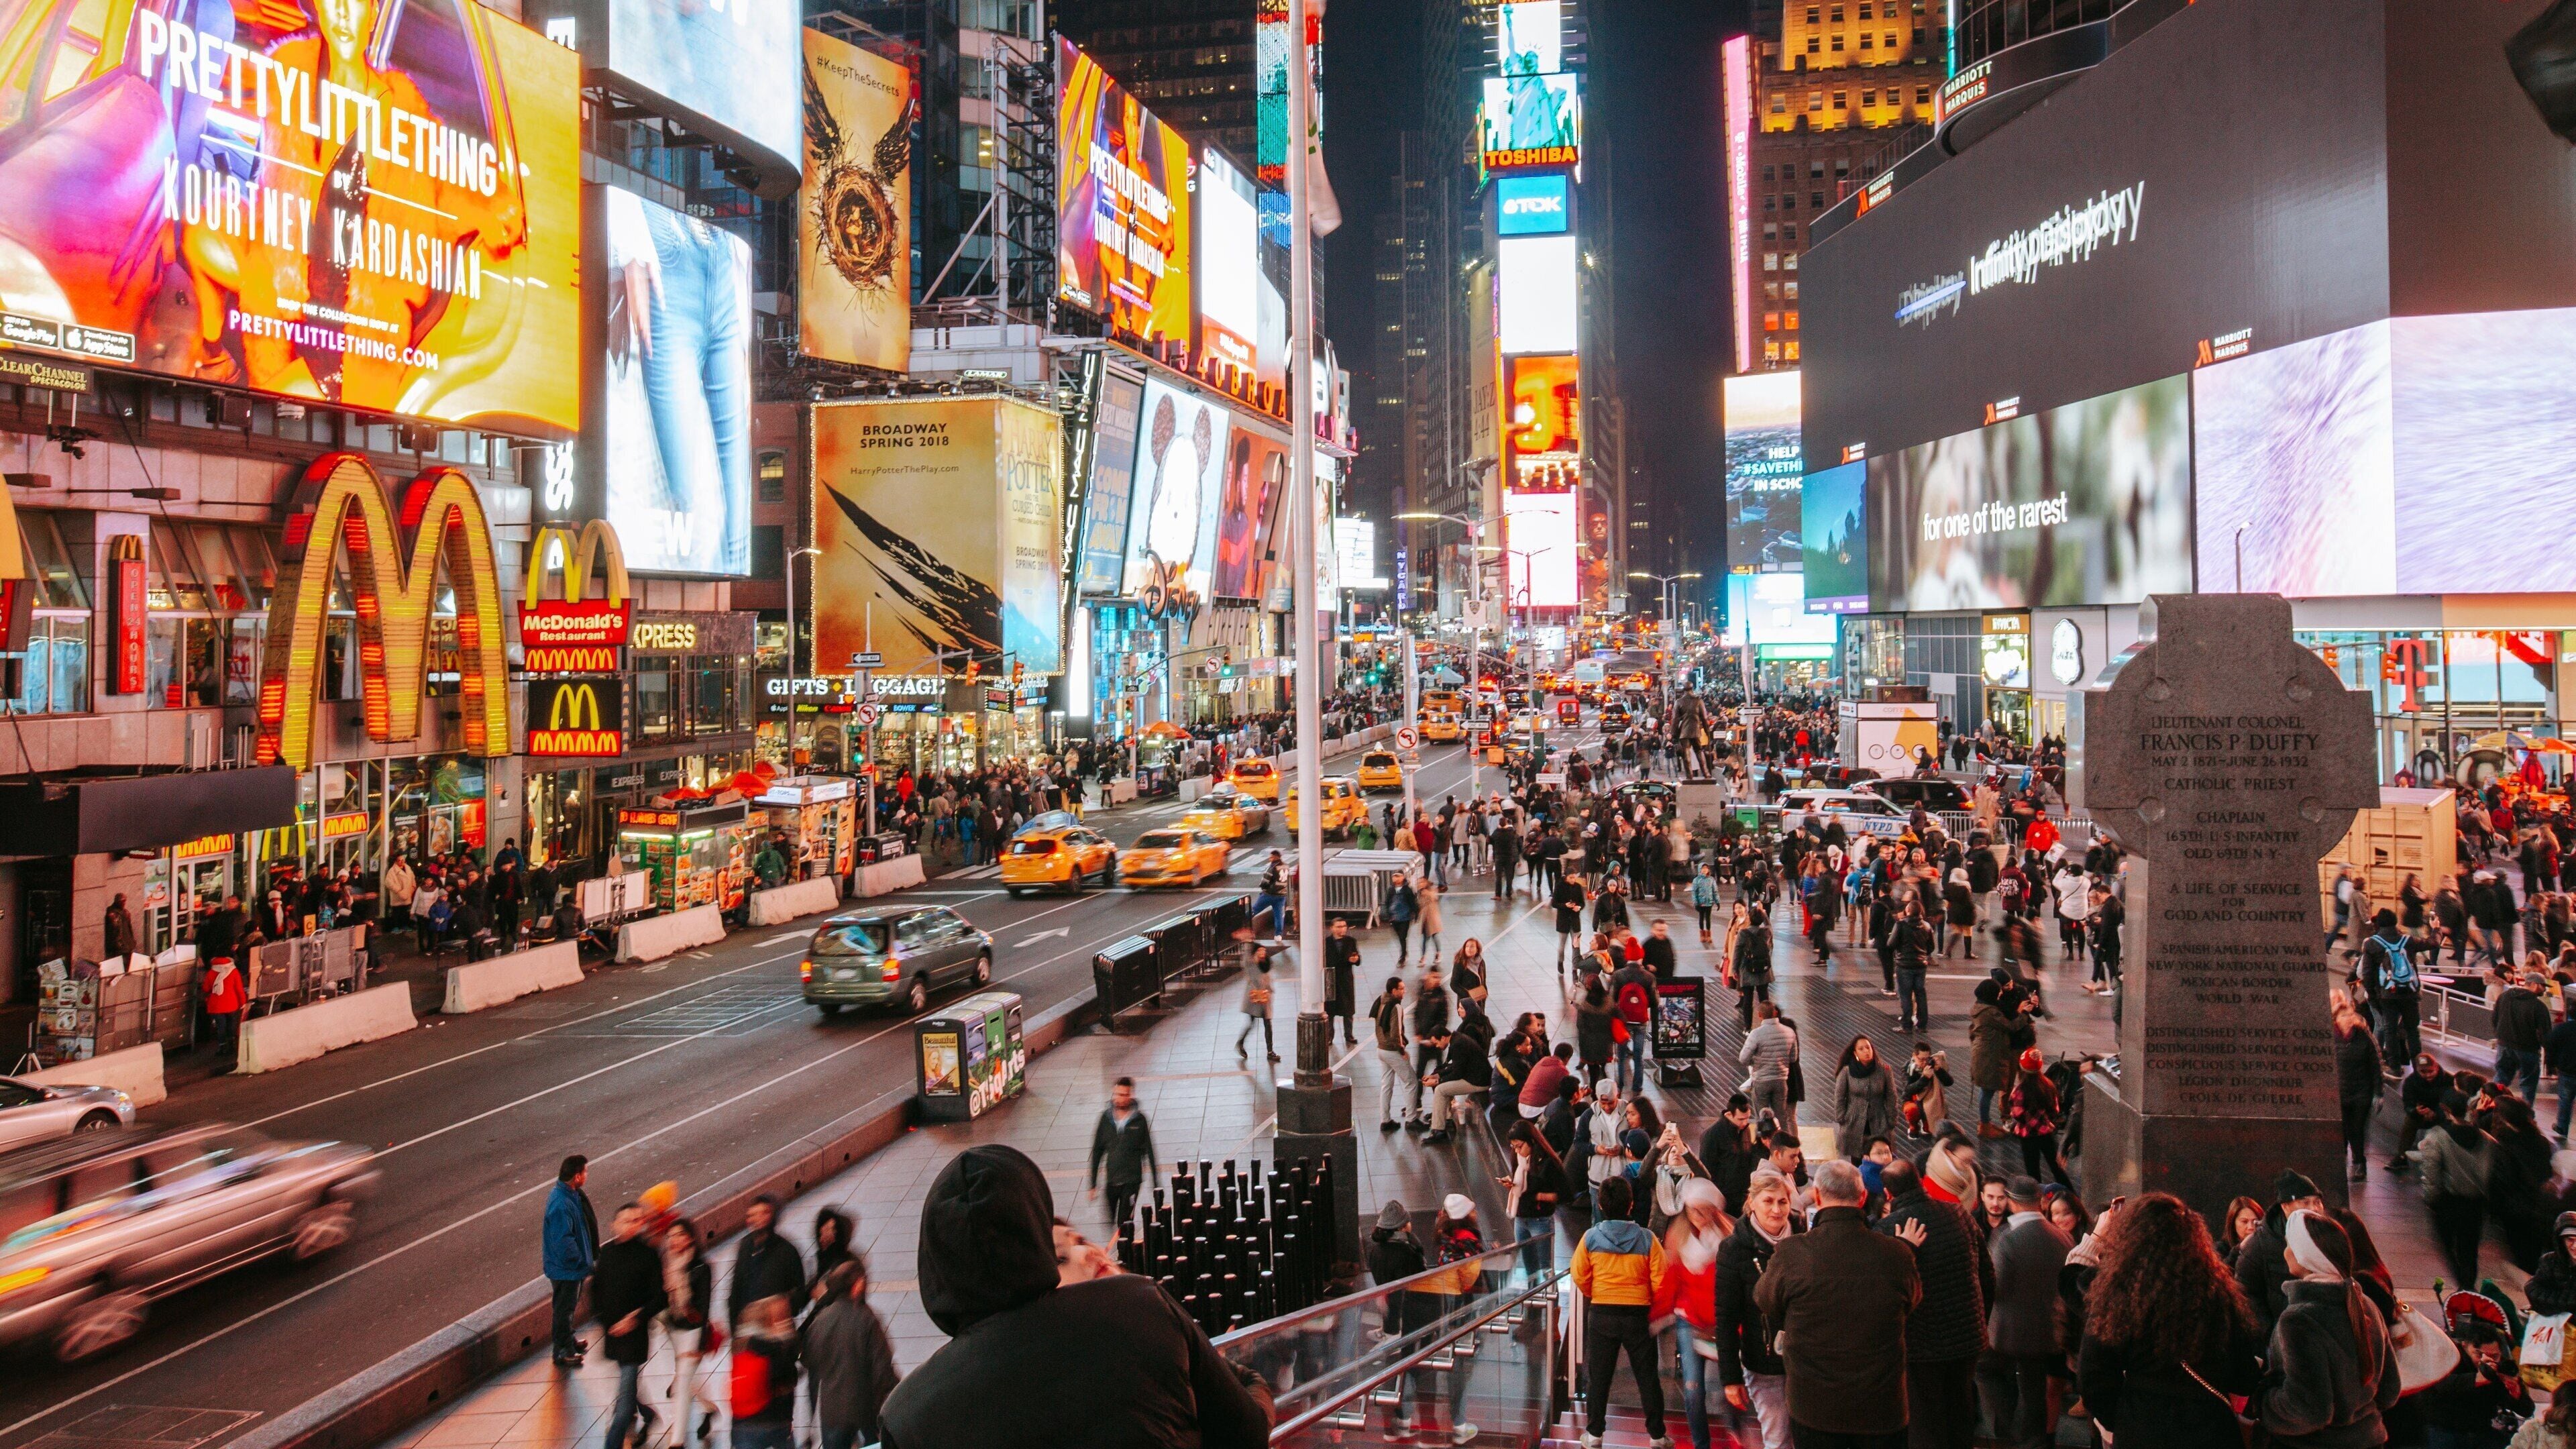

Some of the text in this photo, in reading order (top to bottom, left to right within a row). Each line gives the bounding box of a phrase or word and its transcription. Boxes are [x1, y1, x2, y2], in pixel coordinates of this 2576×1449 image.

[816, 55, 900, 98] #KeepTheSecrets
[1945, 61, 1992, 97] MARRIOTT
[1945, 81, 1985, 115] MARQUIS
[140, 13, 497, 197] PRETTYLITTLETHING
[1486, 146, 1576, 166] TOSHIBA
[333, 170, 352, 191] BY
[1089, 141, 1169, 225] PRETTYLITTLETHING
[1869, 171, 1894, 195] MARRIOTT
[1869, 185, 1891, 207] MARQUIS
[164, 157, 480, 301] KOURTNEY KARDASHIAN
[303, 303, 318, 316] THE
[3, 323, 56, 345] Google Play
[229, 309, 439, 370] PRETTYLITTLETHING.COM
[2214, 328, 2252, 347] MARRIOTT
[83, 338, 129, 357] App Store
[2215, 341, 2248, 360] MARQUIS
[30, 375, 87, 390] SPECTACOLOR
[1155, 331, 1224, 388] 1540
[1226, 365, 1336, 441] BROAAY
[1996, 396, 2020, 411] MARRIOTT
[863, 423, 947, 435] BROADWAY
[860, 436, 950, 448] SPRING 2018
[1010, 419, 1053, 463] HARRY
[1769, 446, 1799, 459] HELP
[850, 464, 959, 476] HarryPotterThePlay.com
[1006, 452, 1056, 496] POTTER
[1754, 480, 1768, 491] IN
[1923, 491, 2068, 541] for one of the rarest
[1016, 546, 1049, 559] BROADWAY
[1016, 559, 1036, 570] SPRING
[127, 568, 141, 687] OPEN 24 HOURS
[524, 614, 623, 631] McDonald's
[539, 631, 606, 641] Restaurant
[633, 623, 696, 649] XPRESS
[767, 678, 946, 696] GIFTS LGGAGE
[796, 704, 819, 712] Nikon
[2151, 716, 2305, 729] LIEUTENANT COLONEL
[2140, 734, 2222, 751] FRANCIS
[2249, 734, 2319, 751] DUFFY
[2151, 756, 2178, 767] MAY
[2180, 756, 2188, 767] 2
[2262, 756, 2276, 767] 26
[2281, 756, 2308, 767] 1932
[611, 774, 645, 788] EXPRESS
[660, 769, 689, 782] EXPRESS
[2164, 778, 2296, 790] CATHOLIC PRIEST
[2196, 812, 2265, 823] CHAPLAIN
[1864, 822, 1892, 831] NYPD
[2166, 831, 2202, 842] 165TH
[2184, 849, 2212, 859] OLD
[2217, 849, 2247, 859] 69TH
[2169, 883, 2302, 895] A LIFE OF SERVICE
[2222, 898, 2245, 906] FOR
[2164, 910, 2306, 922] GOD AND COUNTRY
[2161, 945, 2310, 956] SPANISH AMERICAN WAR
[2147, 960, 2326, 972] NEW YORK NATIONAL GUARD
[2180, 977, 2292, 987] MEXICAN BORDER
[2196, 993, 2279, 1004] WORLD WAR
[924, 1035, 956, 1044] Beautiful
[2147, 1027, 2332, 1039] DISTINGUISHED SERVICE CROSS
[2147, 1043, 2236, 1054] DISTINGUISHED
[2241, 1044, 2288, 1055] SERVICE
[2147, 1059, 2333, 1073] CONSPICUOUS SERVICE CROSS
